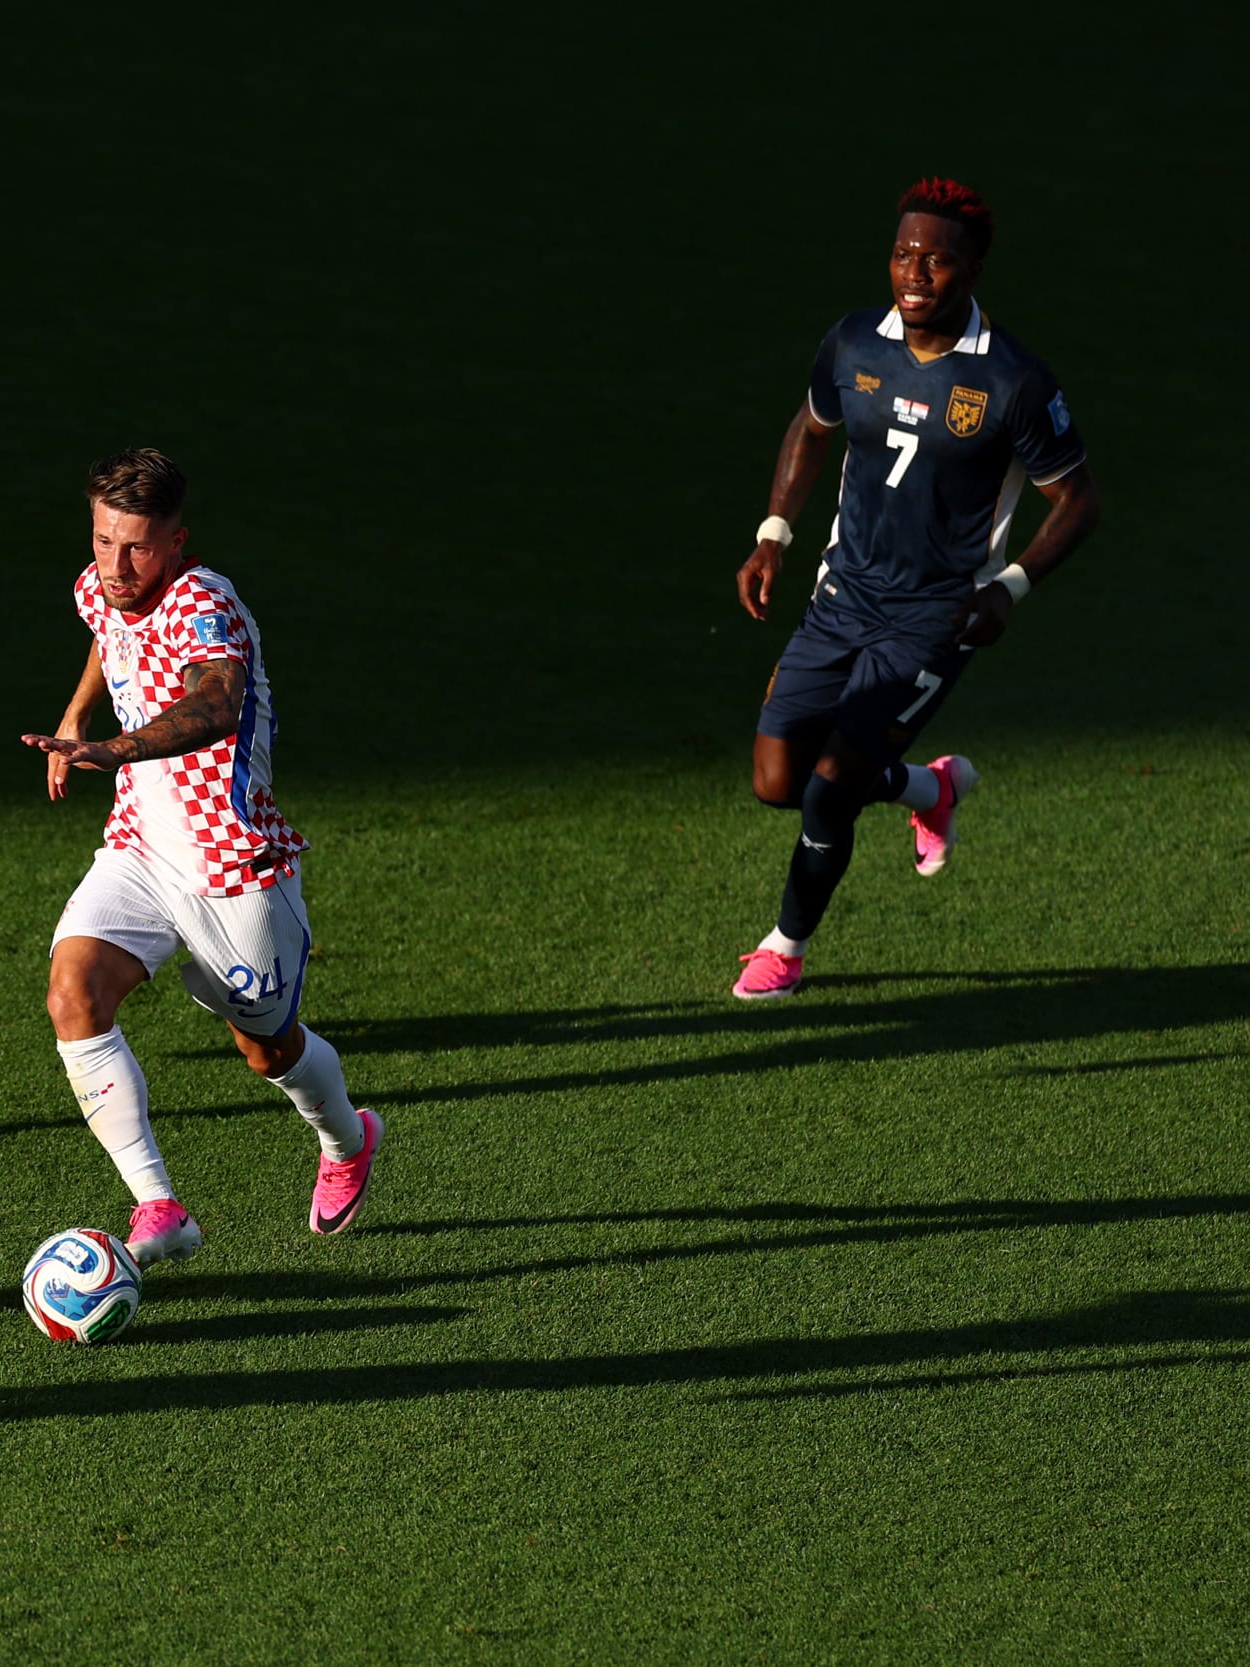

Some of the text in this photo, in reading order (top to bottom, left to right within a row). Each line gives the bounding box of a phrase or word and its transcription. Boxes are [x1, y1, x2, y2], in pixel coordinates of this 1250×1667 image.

[885, 427, 919, 489] 7
[897, 669, 943, 724] 7
[226, 955, 288, 1008] 24
